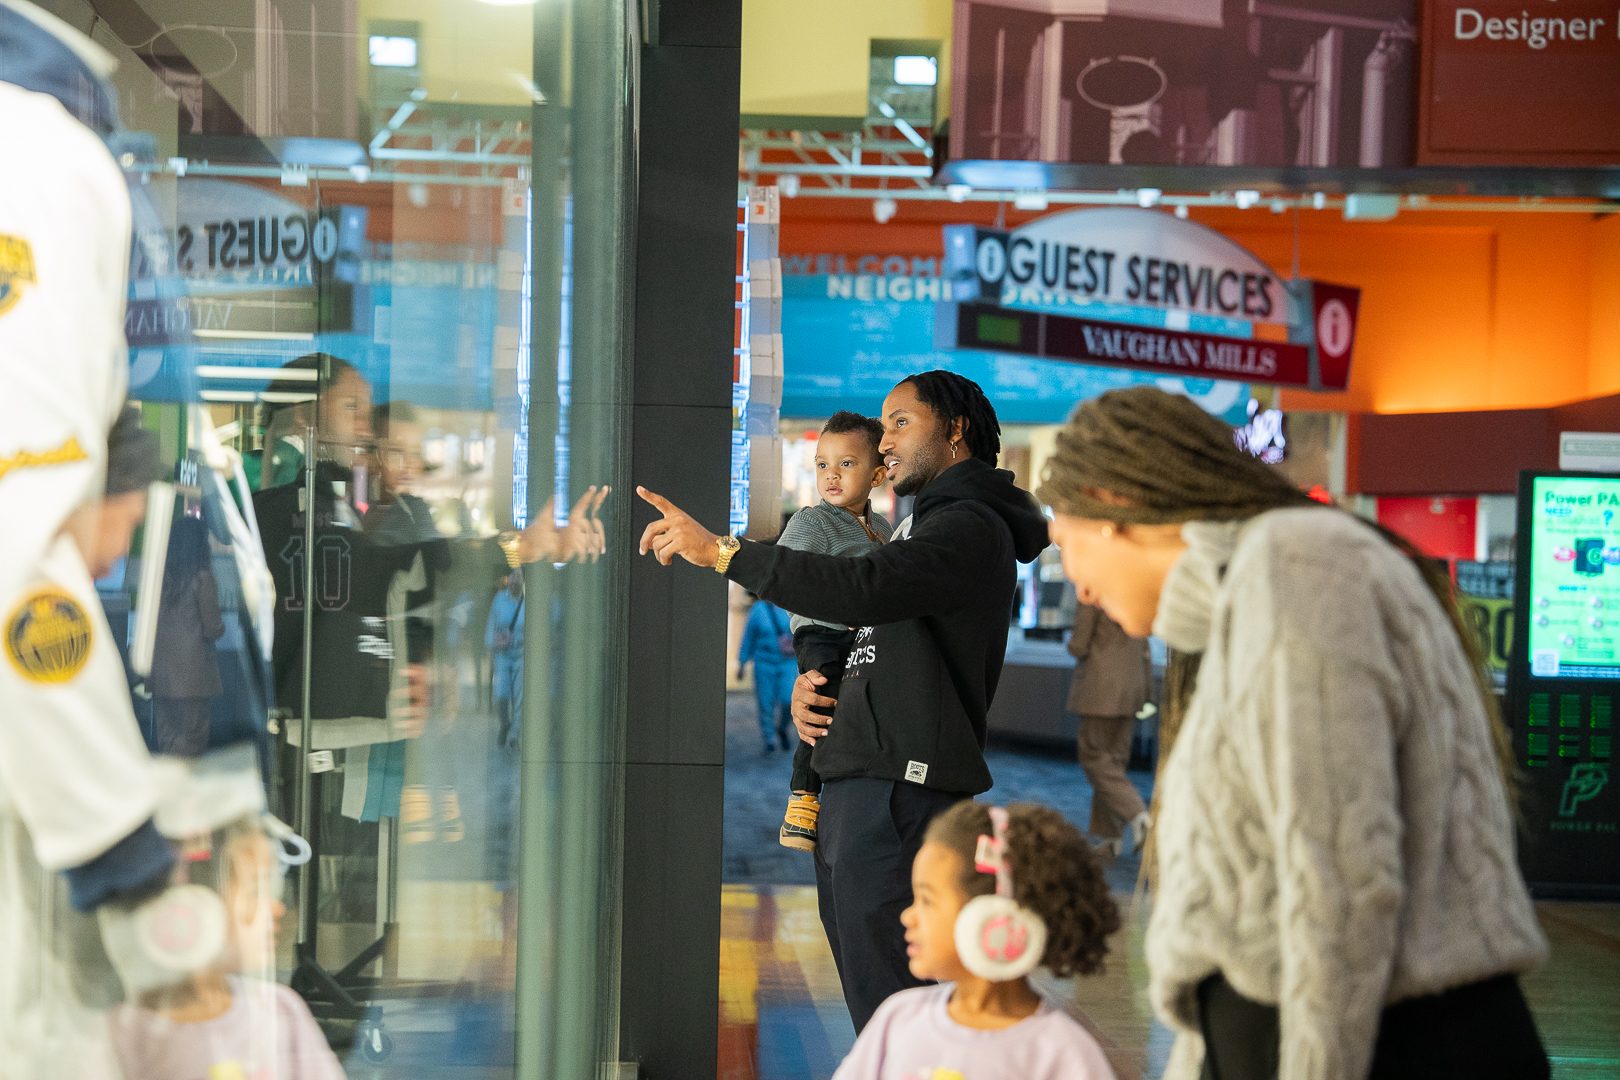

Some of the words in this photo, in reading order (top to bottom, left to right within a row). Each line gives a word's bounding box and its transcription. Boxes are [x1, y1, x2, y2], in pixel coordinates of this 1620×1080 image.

[1455, 8, 1605, 49] Designer
[1010, 237, 1115, 296] GUEST
[1126, 256, 1273, 317] SERVICES
[1082, 325, 1199, 366] VAUGHAN
[1204, 343, 1277, 376] MILLS
[1545, 491, 1592, 504] Power
[280, 535, 350, 611] 10
